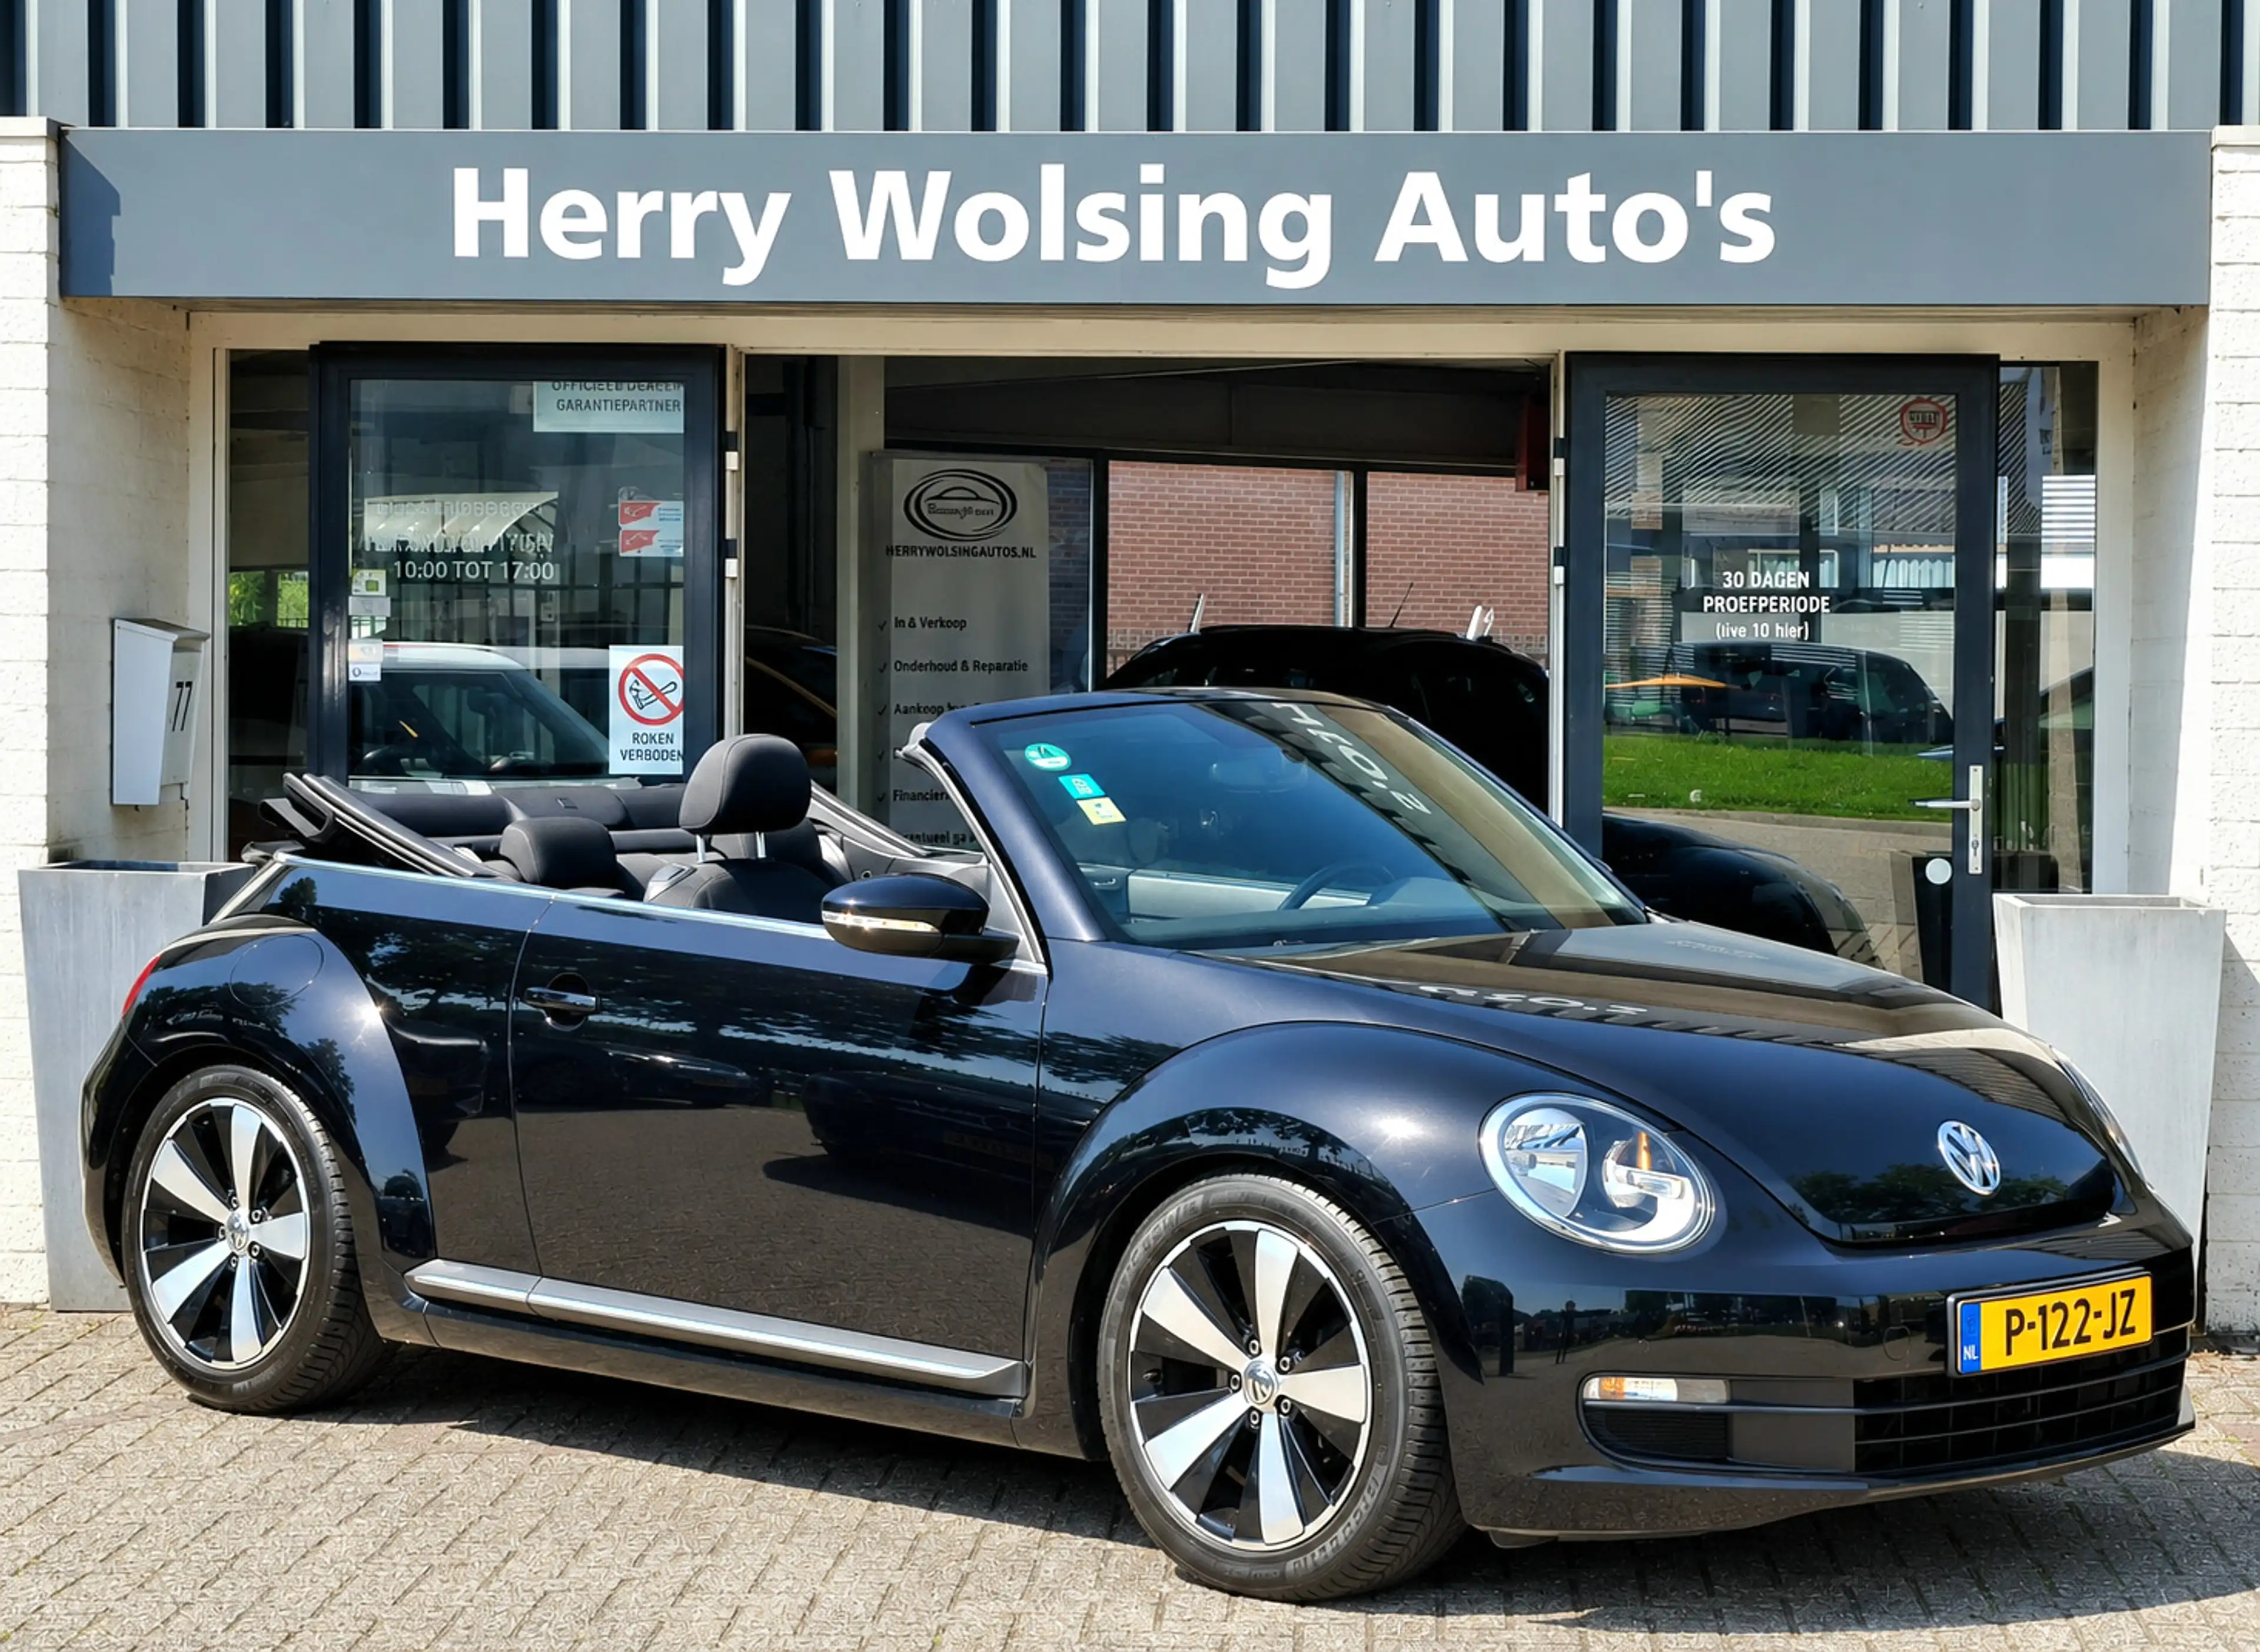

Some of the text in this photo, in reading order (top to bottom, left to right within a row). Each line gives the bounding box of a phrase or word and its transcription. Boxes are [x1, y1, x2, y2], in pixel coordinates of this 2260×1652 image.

[454, 164, 1775, 290] Herry Wolsing Auto's
[556, 398, 681, 412] GARANTIEPARTNER
[394, 560, 555, 580] 10:00 TOT 17:00
[1722, 571, 1810, 589] 30 DAGEN
[1703, 596, 1830, 613] PROEFPERIODE
[893, 617, 967, 631] In & Verkoop
[1752, 622, 1769, 638] 10
[893, 659, 1029, 674] Onderhoud & Reparatie
[893, 703, 945, 716] Aankoop
[632, 732, 674, 745] ROKEN
[2005, 1288, 2136, 1357] P-122-JZ
[1963, 1345, 1979, 1361] NL
